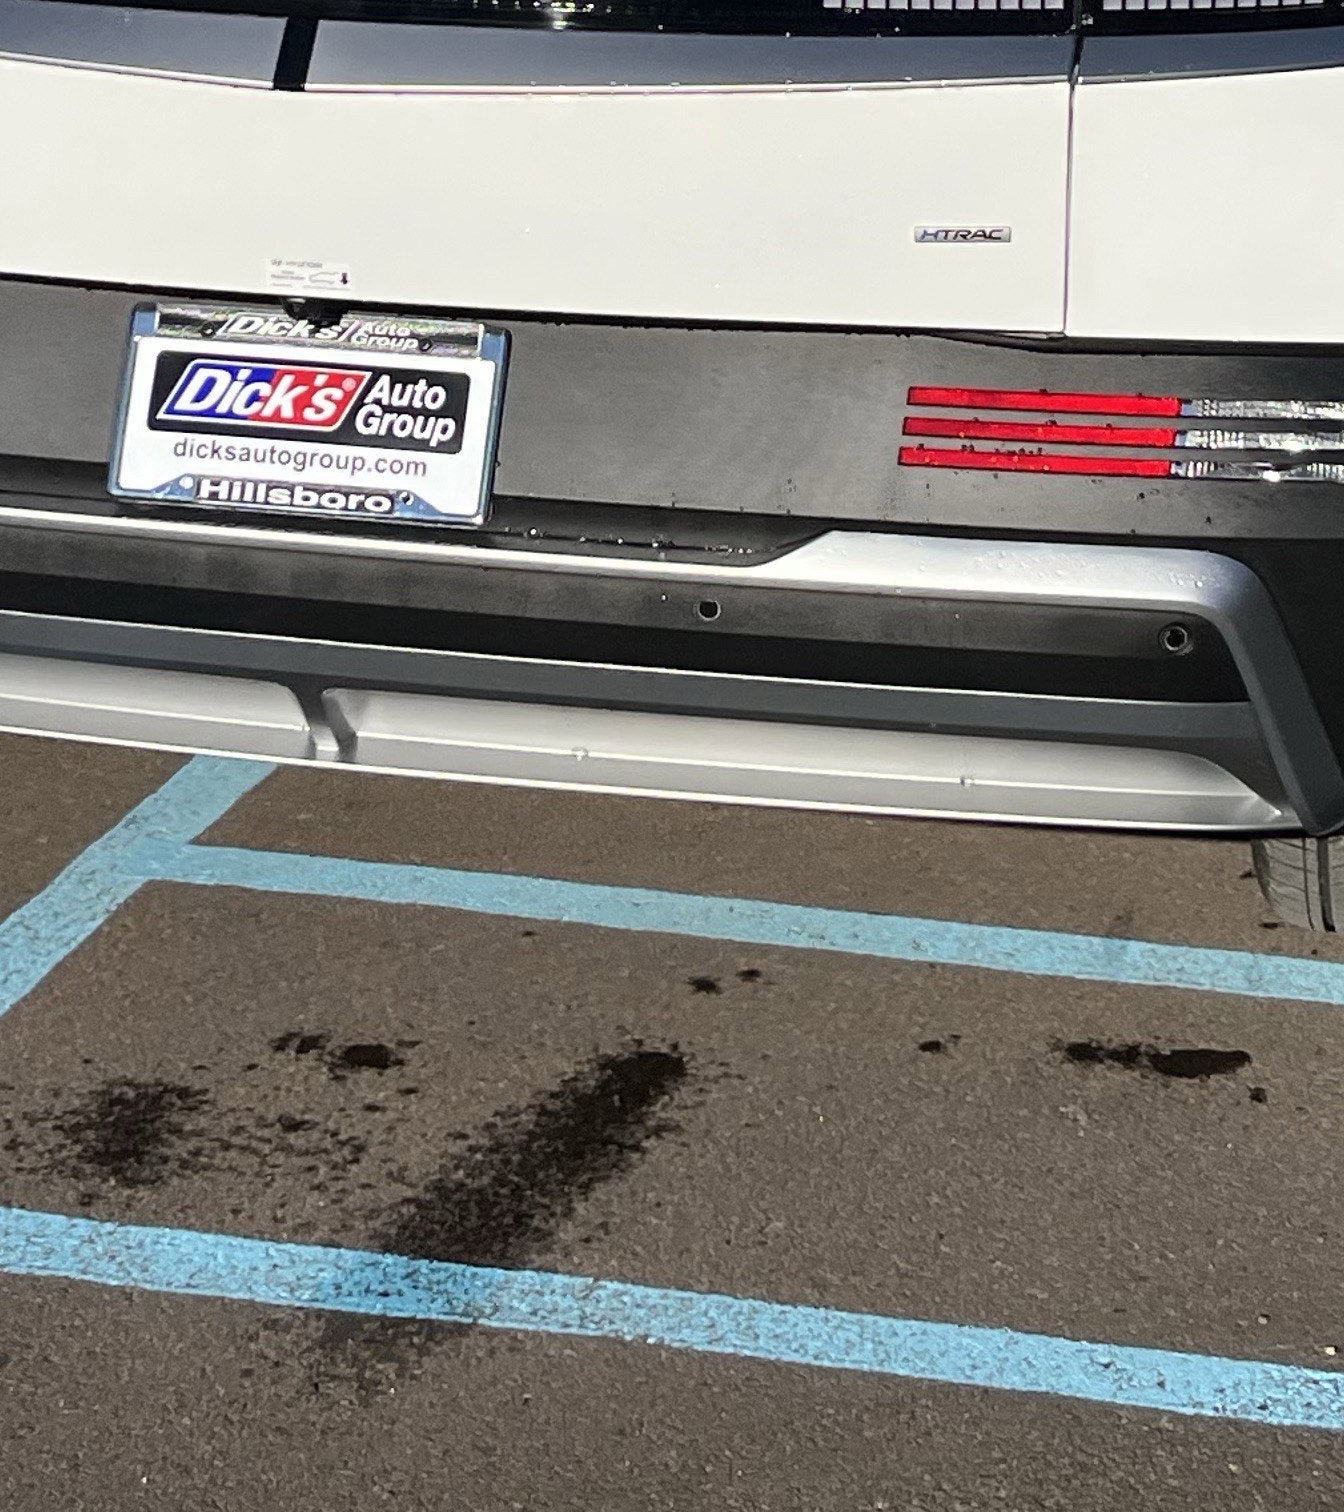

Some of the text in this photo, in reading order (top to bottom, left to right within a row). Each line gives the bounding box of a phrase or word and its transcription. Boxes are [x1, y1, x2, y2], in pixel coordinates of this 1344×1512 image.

[920, 228, 1004, 241] HTRAC
[227, 316, 343, 339] Dicks
[351, 335, 419, 350] Group
[358, 320, 413, 336] Auto
[173, 368, 344, 423] Dick's
[364, 374, 446, 409] Auto
[355, 405, 456, 447] Group
[173, 438, 427, 477] dicksautogroup.com
[198, 477, 393, 513] Hillsboro
